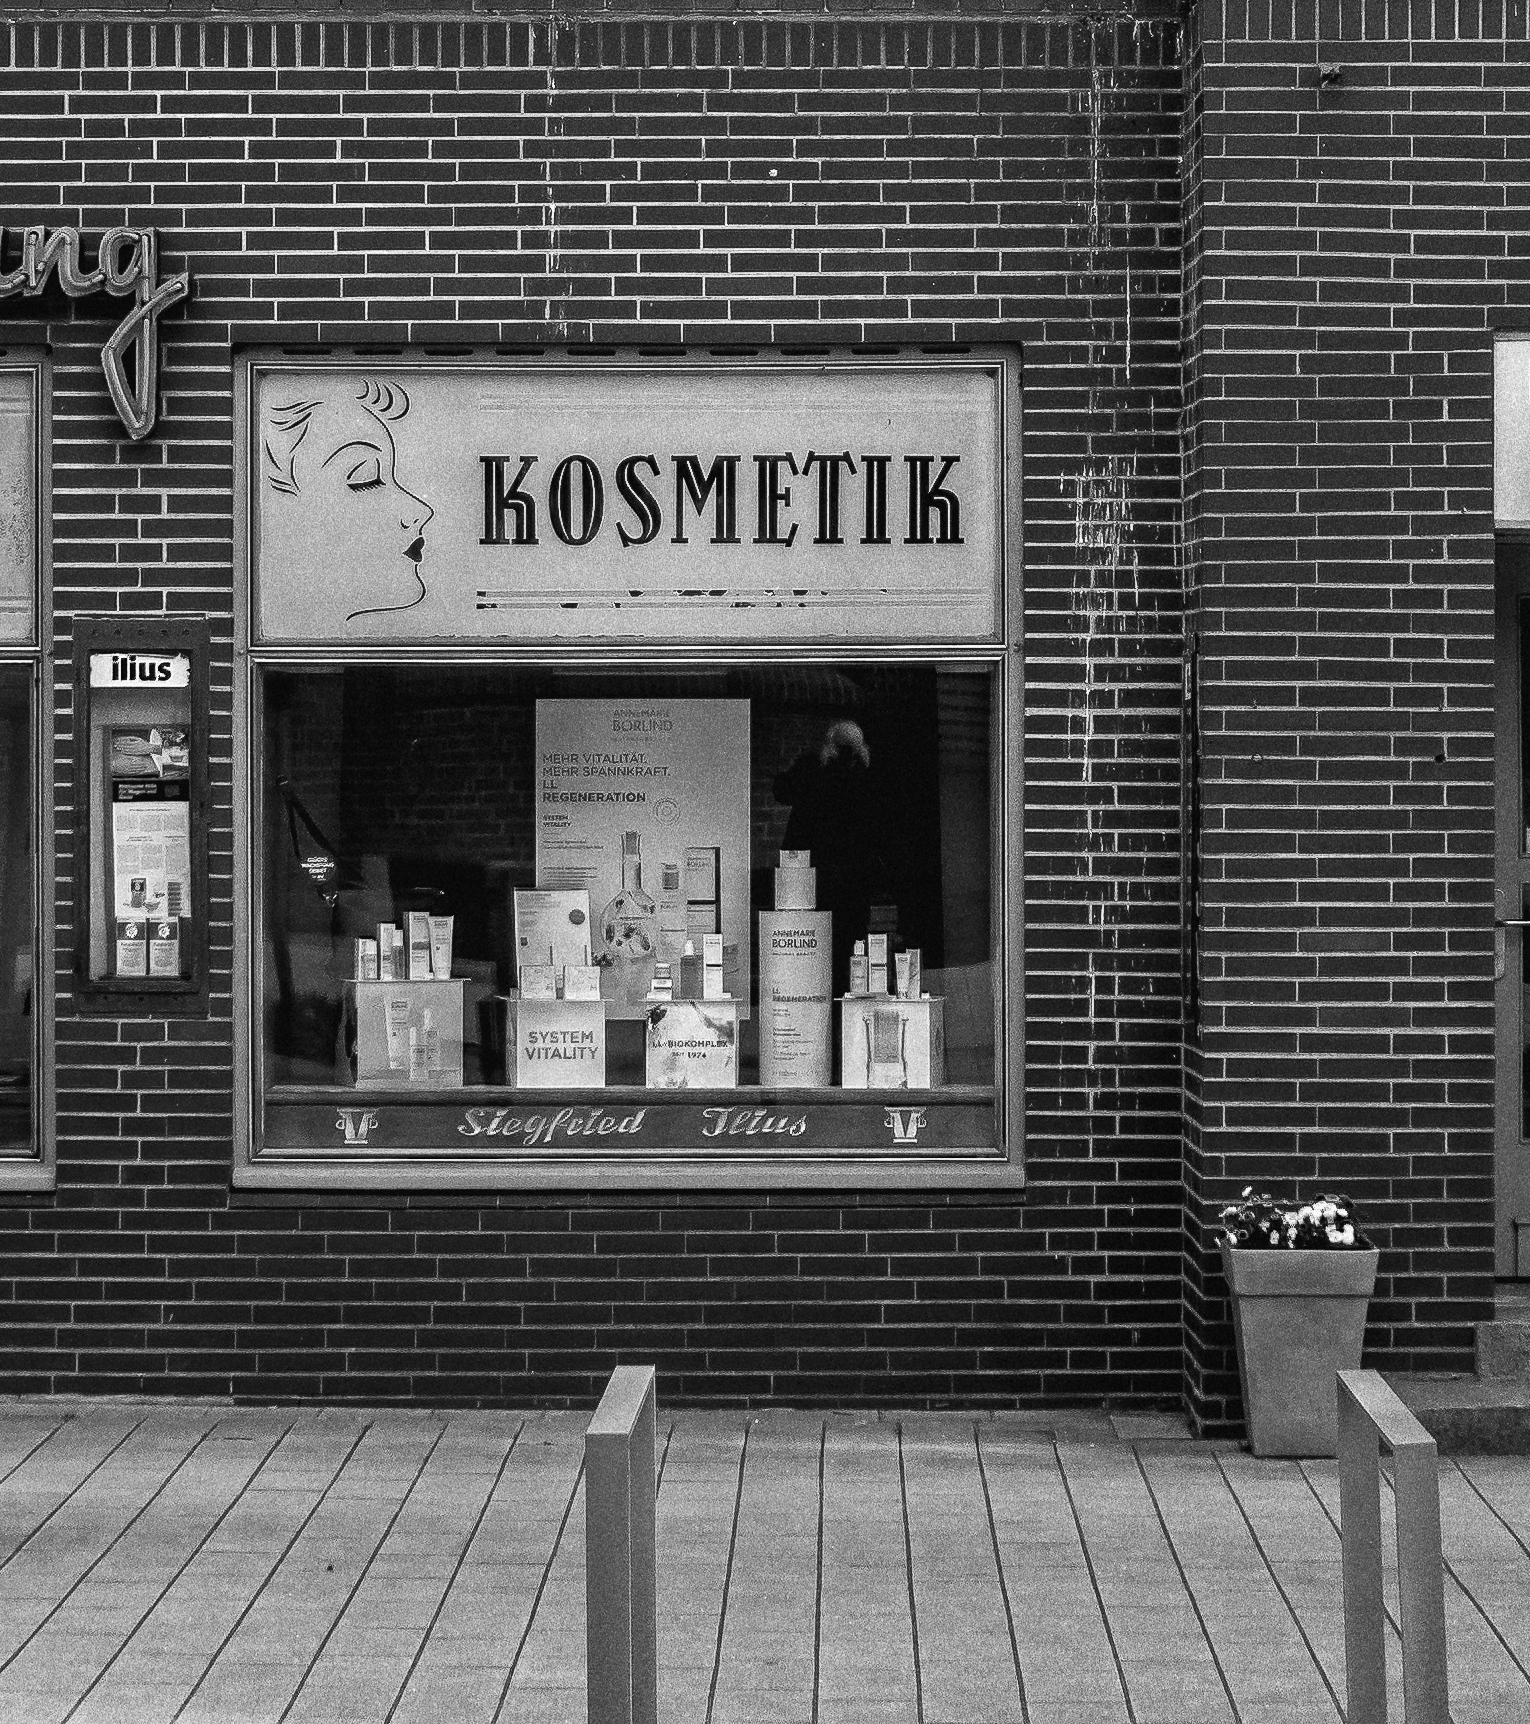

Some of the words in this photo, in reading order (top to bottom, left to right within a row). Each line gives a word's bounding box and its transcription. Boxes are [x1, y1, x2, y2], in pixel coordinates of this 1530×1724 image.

[478, 450, 965, 548] KOSMETIK
[112, 655, 172, 682] ilius
[542, 753, 579, 764] MEHR
[542, 766, 579, 777] MEHR
[583, 766, 671, 777] SPANNKRAFT.
[542, 792, 647, 803] REGENERATION
[528, 1031, 594, 1044] SYSTEM
[525, 1047, 599, 1060] VITALITY
[457, 1107, 647, 1146] Siegfried
